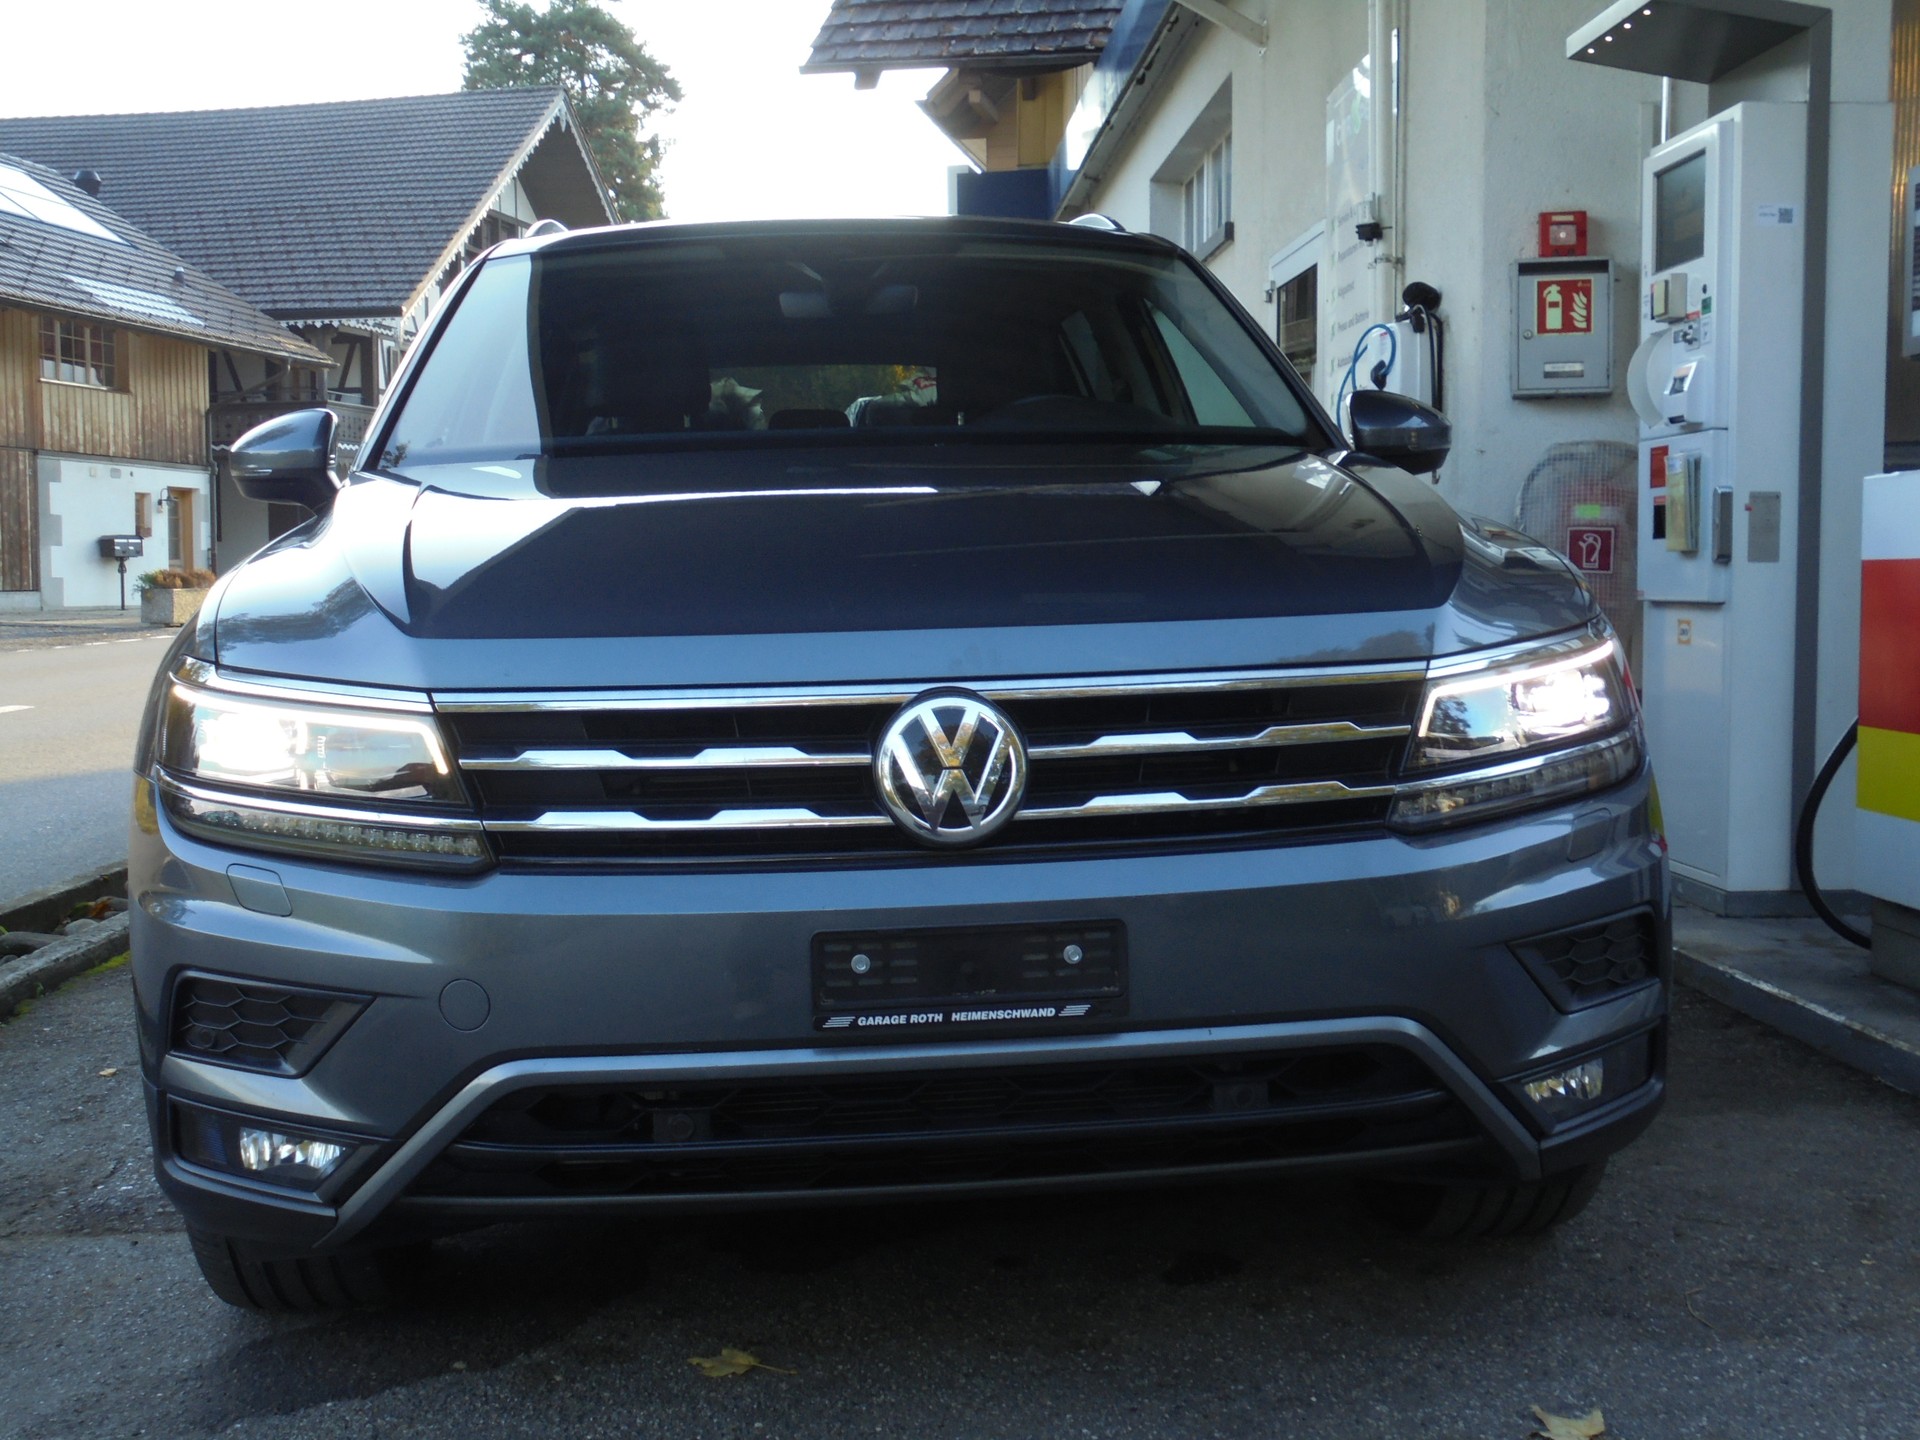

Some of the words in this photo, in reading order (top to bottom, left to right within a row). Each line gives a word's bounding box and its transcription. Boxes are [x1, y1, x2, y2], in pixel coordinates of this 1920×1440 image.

[885, 701, 1019, 835] VW
[857, 1014, 907, 1026] GARAGE
[910, 1012, 943, 1024] ROTH
[951, 1007, 1056, 1022] HEIMENSCHWAND
